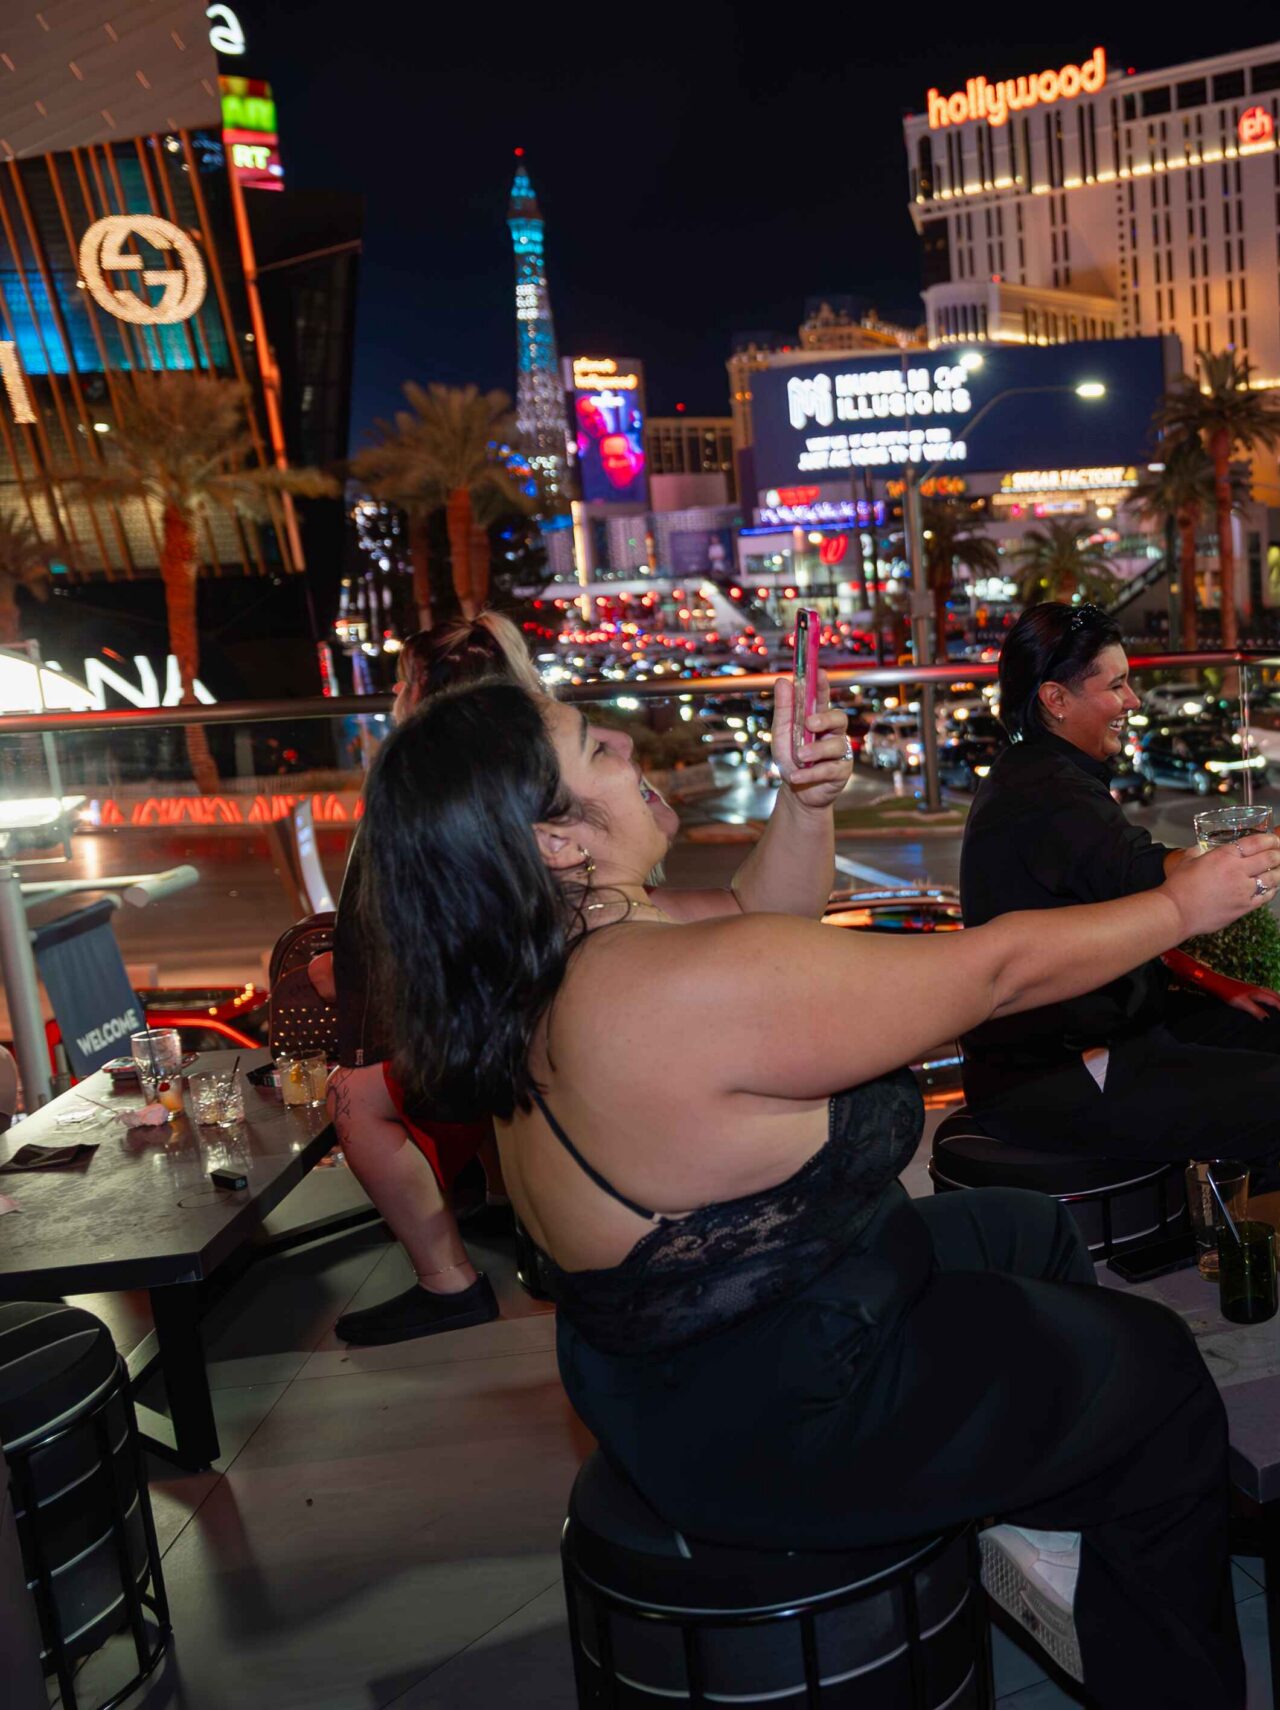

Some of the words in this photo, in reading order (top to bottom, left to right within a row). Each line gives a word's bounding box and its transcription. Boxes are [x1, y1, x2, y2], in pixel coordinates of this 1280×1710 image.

[927, 46, 1107, 129] hollywood
[836, 388, 972, 421] ILLUSIONS
[75, 1008, 141, 1057] WELCOME
